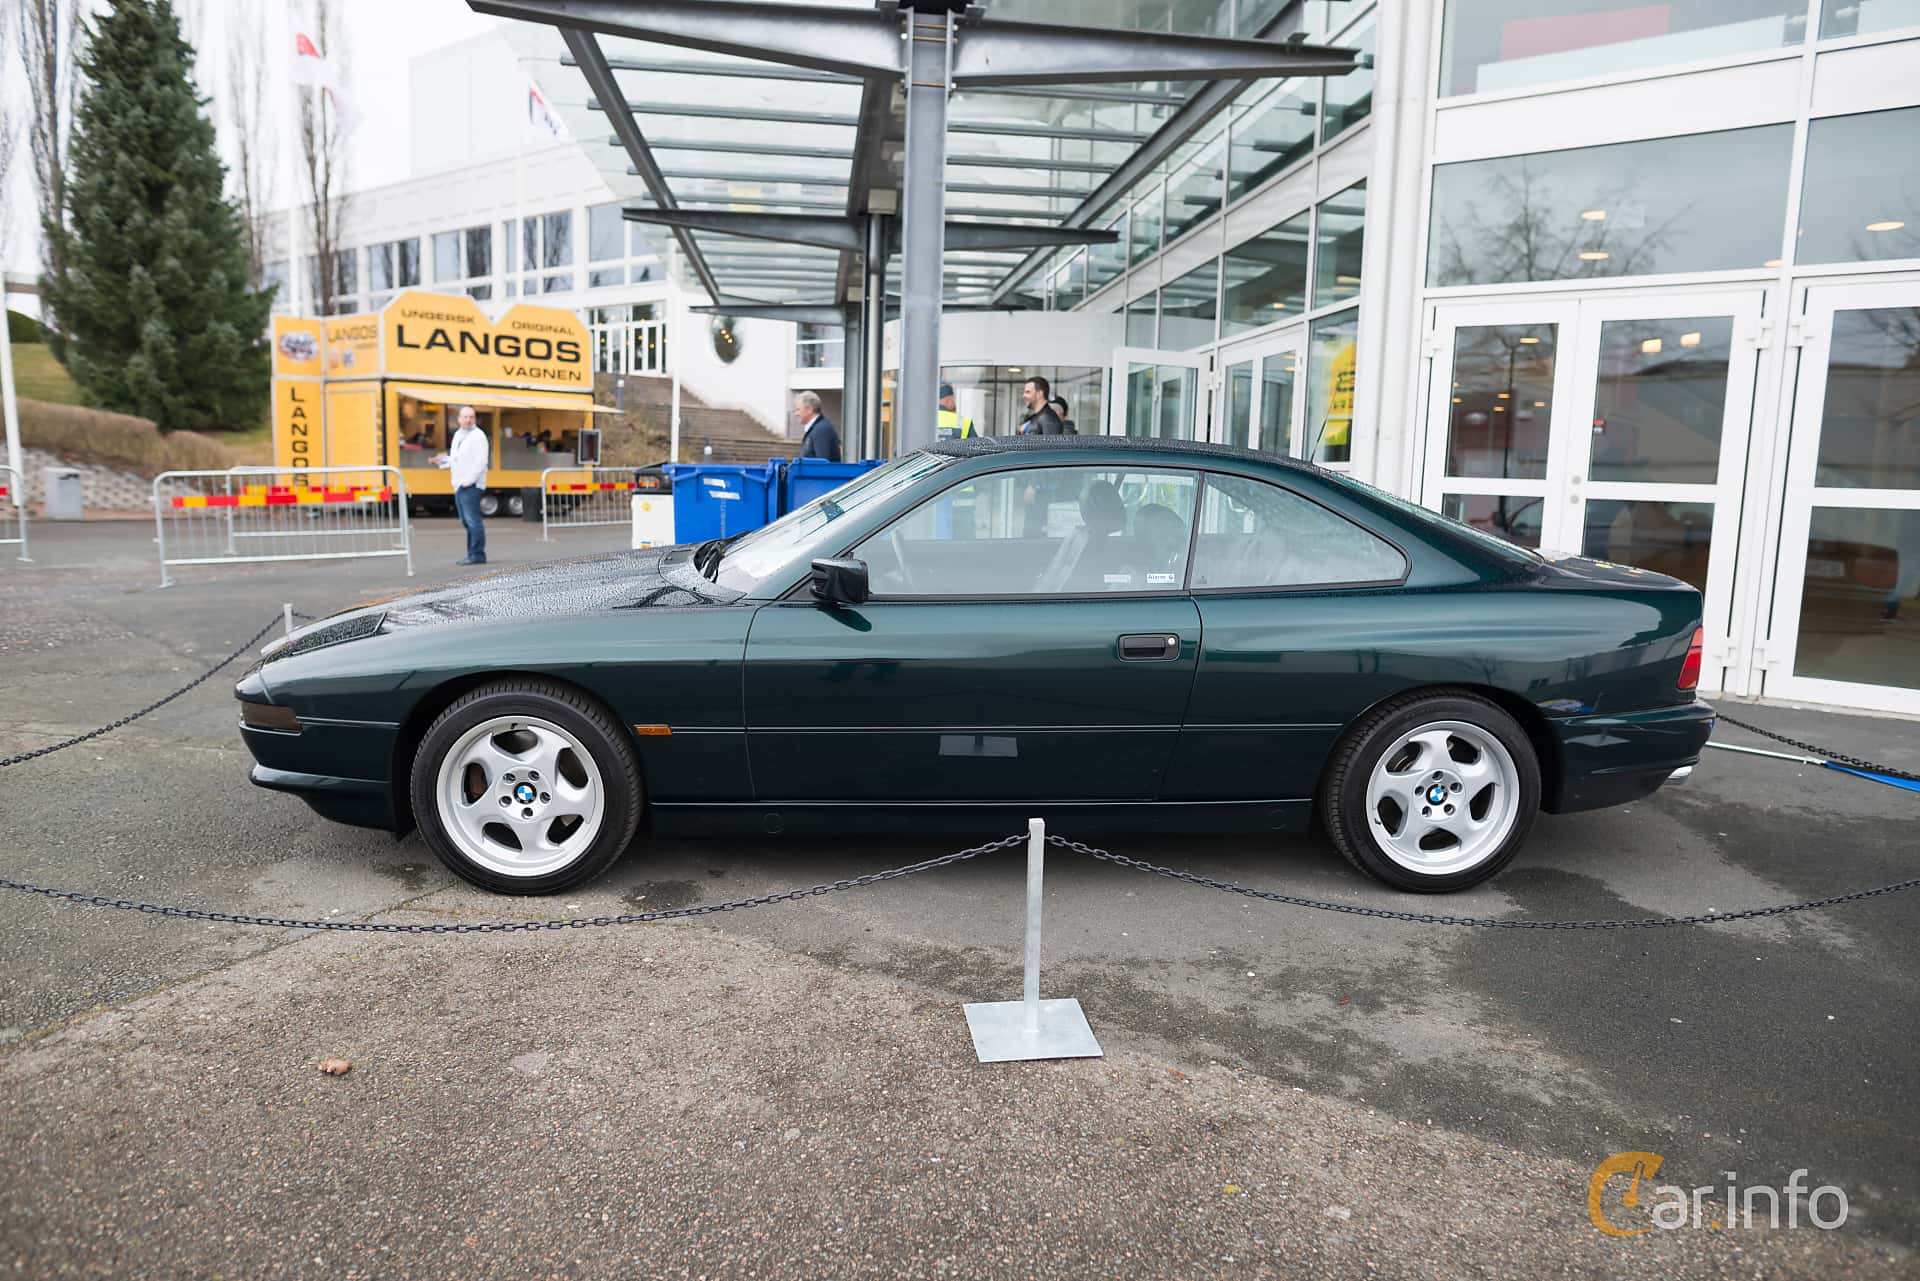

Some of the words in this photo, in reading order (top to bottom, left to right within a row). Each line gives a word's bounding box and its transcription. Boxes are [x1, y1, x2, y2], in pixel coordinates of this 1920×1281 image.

[401, 309, 475, 324] UNGERSK
[511, 320, 575, 336] ORIGINAL
[397, 324, 581, 363] LANGOS
[503, 365, 582, 381] VAGNEN
